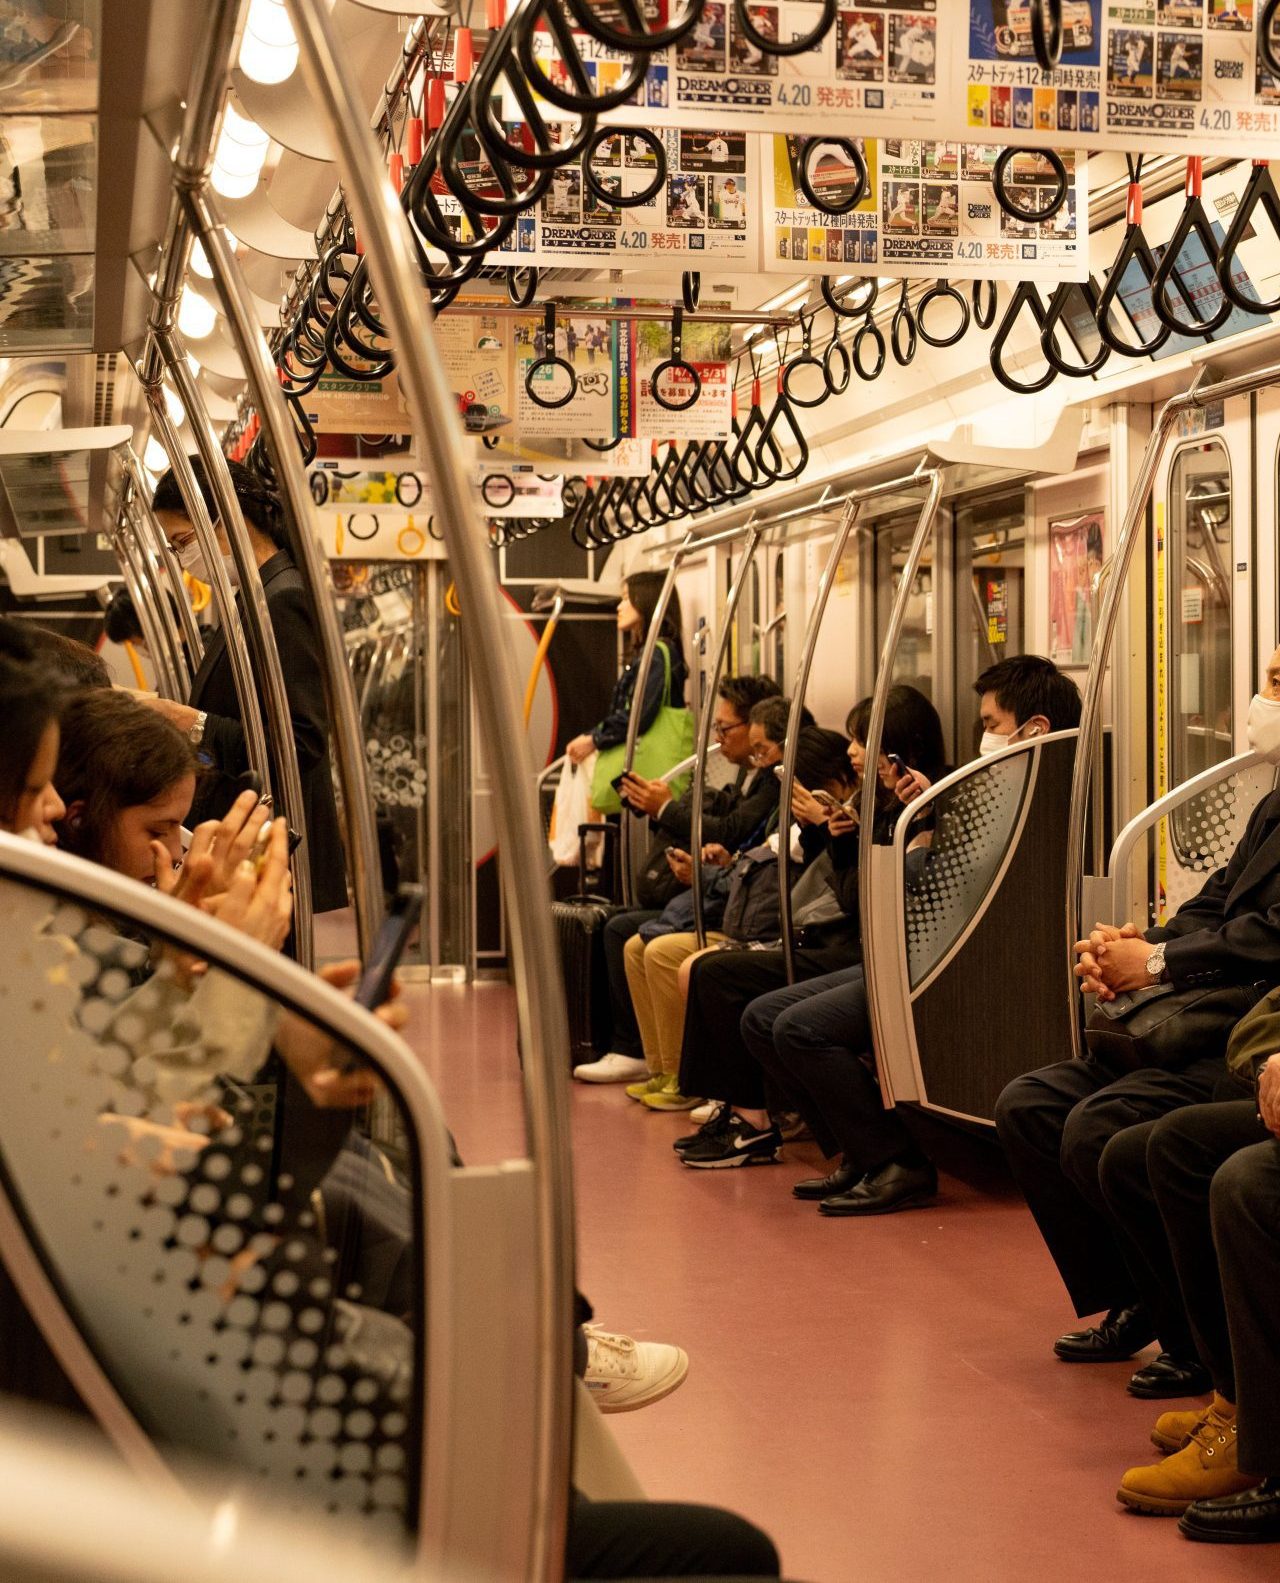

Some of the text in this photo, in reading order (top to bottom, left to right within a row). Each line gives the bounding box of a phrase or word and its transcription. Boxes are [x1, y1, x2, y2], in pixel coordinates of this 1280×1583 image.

[777, 84, 811, 106] 4.20
[1200, 108, 1231, 130] 4.20
[620, 231, 647, 249] 4.20
[651, 233, 686, 249] 発売!
[957, 242, 1020, 260] 4.20 発売!
